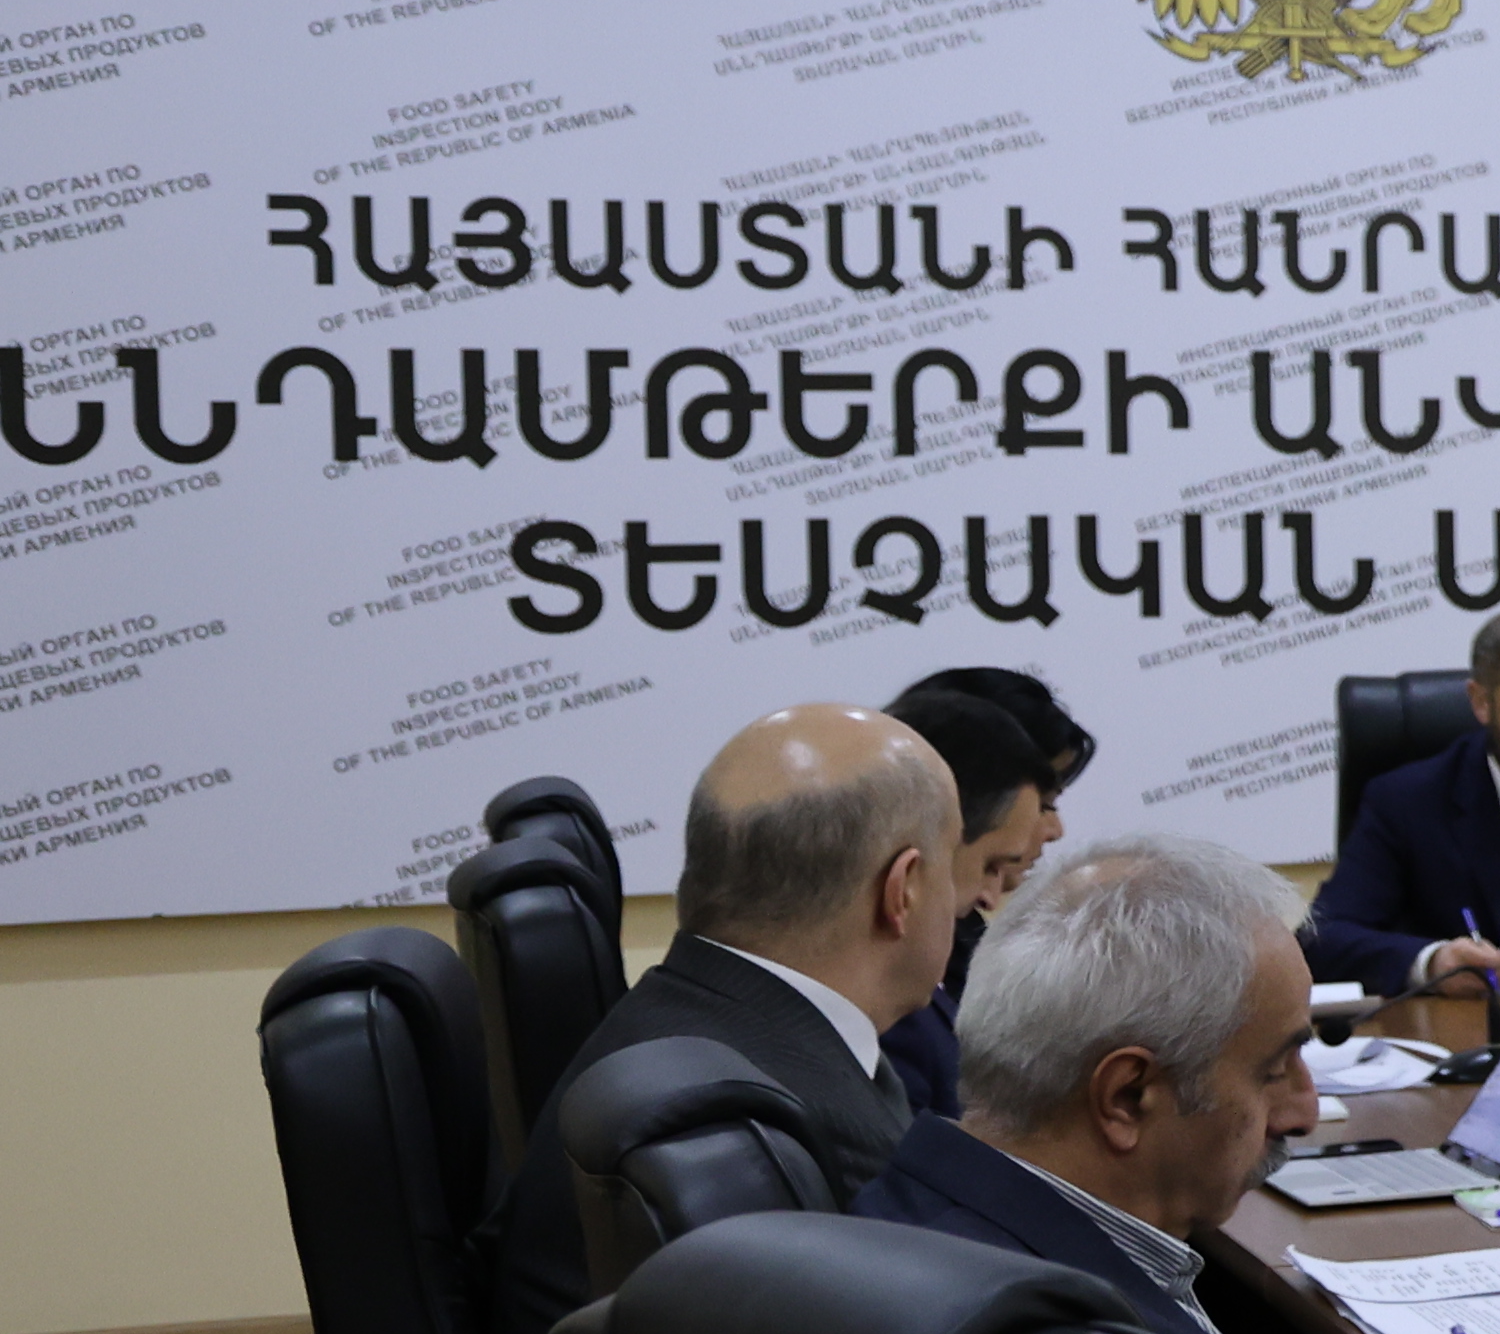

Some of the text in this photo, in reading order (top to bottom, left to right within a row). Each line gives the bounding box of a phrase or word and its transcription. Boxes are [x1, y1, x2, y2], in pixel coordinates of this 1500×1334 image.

[18, 14, 136, 48] ОРГАН ПО
[308, 17, 337, 37] OF
[343, 8, 387, 28] THE
[68, 24, 207, 60] ПРОДУКТОВ
[7, 64, 121, 97] АРМЕНИЯ
[387, 80, 534, 123] FOOD SAFETY
[372, 96, 563, 148] INSPECTION BODY
[313, 104, 637, 185] OF THE REPUBLIC OF ARMENIA
[24, 165, 142, 200] ОРГАН ПО
[73, 174, 212, 211] ПРОДУКТОВ
[13, 215, 127, 249] АРМЕНИЯ
[266, 193, 1076, 296] ՀԱՅԱՍՏԱՆԻ
[29, 315, 147, 352] ОРГАН ПО
[318, 303, 397, 332] OF THE
[0, 344, 1191, 470] ՆՆԴԱՄԹԵՐՔԻ
[35, 466, 151, 503] ОРГАН ПО
[84, 473, 222, 513] ПРОДУКТОВ
[24, 515, 138, 553] АРМЕНИЯ
[401, 536, 464, 562] FOOD
[386, 550, 508, 588] INSPECTION
[507, 510, 1378, 635] ՏԵՍՉԱԿԱՆ
[327, 571, 513, 627] OF THE REPUBLIC
[1345, 595, 1433, 630] АРМЕНИЯ
[40, 615, 158, 654] ОРГАН ПО
[89, 621, 228, 663] ПРОДУКТОВ
[29, 666, 143, 704] АРМЕНИЯ
[406, 658, 552, 708] FOOD SAFETY
[391, 672, 581, 734] INSPECTION BODY
[332, 676, 655, 774] OF THE REPUBLIC OF ARMENIA
[46, 765, 163, 805] ОРГАН ПО
[94, 770, 233, 813] ПРОДУКТОВ
[35, 815, 148, 855] АРМЕНИЯ
[411, 826, 473, 854] FOOD
